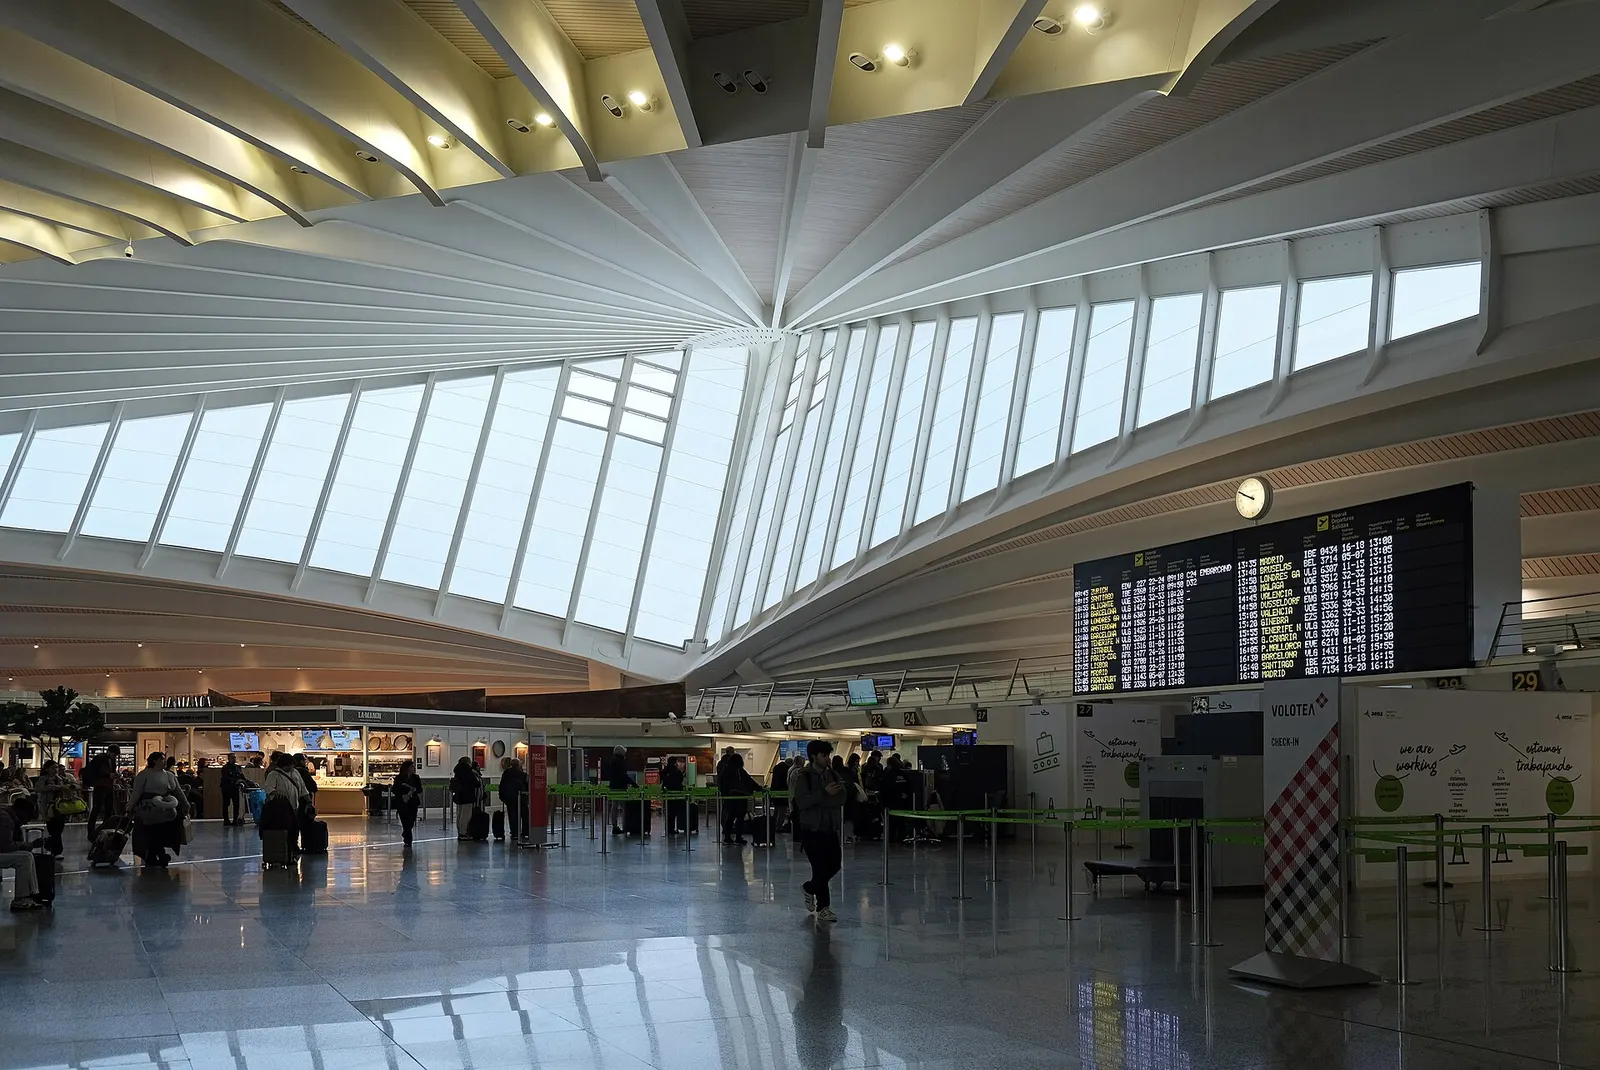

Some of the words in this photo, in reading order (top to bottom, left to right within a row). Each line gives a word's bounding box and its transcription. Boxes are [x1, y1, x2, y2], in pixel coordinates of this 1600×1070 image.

[1260, 555, 1284, 566] MADRID
[1320, 545, 1338, 555] 0434
[1342, 540, 1365, 551] 16-18
[1369, 535, 1393, 546] 13:00
[1260, 563, 1292, 575] BRUSELAS
[1320, 554, 1338, 564] 3714
[1342, 550, 1365, 561] 05-07
[1369, 545, 1393, 555] 13:05
[1260, 572, 1288, 583] LONDRES
[1320, 564, 1338, 573] 6307
[1342, 559, 1365, 570] 11-15
[1369, 554, 1393, 565] 13:15
[1260, 582, 1284, 592] MALAGA
[1320, 573, 1338, 582] 3512
[1342, 569, 1365, 579] 32-32
[1369, 564, 1393, 574] 13:15
[1260, 589, 1292, 601] VALENCIA
[1321, 582, 1338, 592] 3966
[1342, 578, 1365, 589] 11-15
[1369, 574, 1393, 584] 14:10
[1260, 597, 1300, 609] DUSSELDORF
[1321, 591, 1338, 601] 9519
[1343, 588, 1365, 598] 34-35
[1370, 583, 1393, 594] 14:15
[1261, 607, 1293, 618] VALENCIA
[1321, 600, 1339, 610] 3536
[1343, 597, 1365, 607] 30-31
[1370, 593, 1393, 603] 14:30
[1261, 616, 1289, 626] GINEBRA
[1321, 610, 1339, 619] 1362
[1343, 607, 1366, 616] 32-33
[1370, 603, 1394, 613] 14:56
[1261, 624, 1293, 635] TENERIFE
[1321, 619, 1339, 628] 3262
[1343, 616, 1366, 626] 11-15
[1370, 612, 1394, 622] 15:20
[1261, 633, 1297, 644] G.CANARIA
[1321, 628, 1339, 637] 3270
[1343, 625, 1366, 635] 11-15
[1370, 622, 1394, 632] 15:20
[1261, 641, 1301, 652] P.MALLORCA
[1322, 637, 1339, 646] 6211
[1343, 635, 1366, 644] 01-02
[1370, 631, 1394, 642] 15:30
[1262, 650, 1297, 661] BARCELONA
[1322, 646, 1339, 655] 1431
[1343, 644, 1366, 654] 11-15
[1370, 641, 1394, 651] 15:55
[1262, 660, 1293, 670] SANTIAGO
[1322, 656, 1339, 664] 2354
[1344, 654, 1366, 663] 16-18
[1370, 651, 1394, 661] 16:15
[1262, 669, 1286, 678] MADRID
[1322, 665, 1340, 674] 7154
[1344, 663, 1366, 672] 19-20
[1370, 660, 1394, 670] 16:15
[1514, 672, 1537, 691] 29
[905, 713, 916, 724] 24
[978, 711, 986, 720] 27
[1079, 706, 1092, 714] 27
[1272, 704, 1315, 717] VOLOTEA
[712, 723, 720, 732] 19
[735, 722, 742, 731] 20
[794, 719, 802, 729] 21
[812, 718, 821, 728] 22
[872, 715, 882, 726] 23
[1109, 737, 1137, 746] estamos
[1271, 737, 1299, 746] CHECK-IN
[1400, 745, 1414, 754] we
[1416, 745, 1434, 754] are
[1526, 741, 1562, 754] estamos
[1396, 755, 1437, 776] working
[1516, 757, 1572, 777] trabajando
